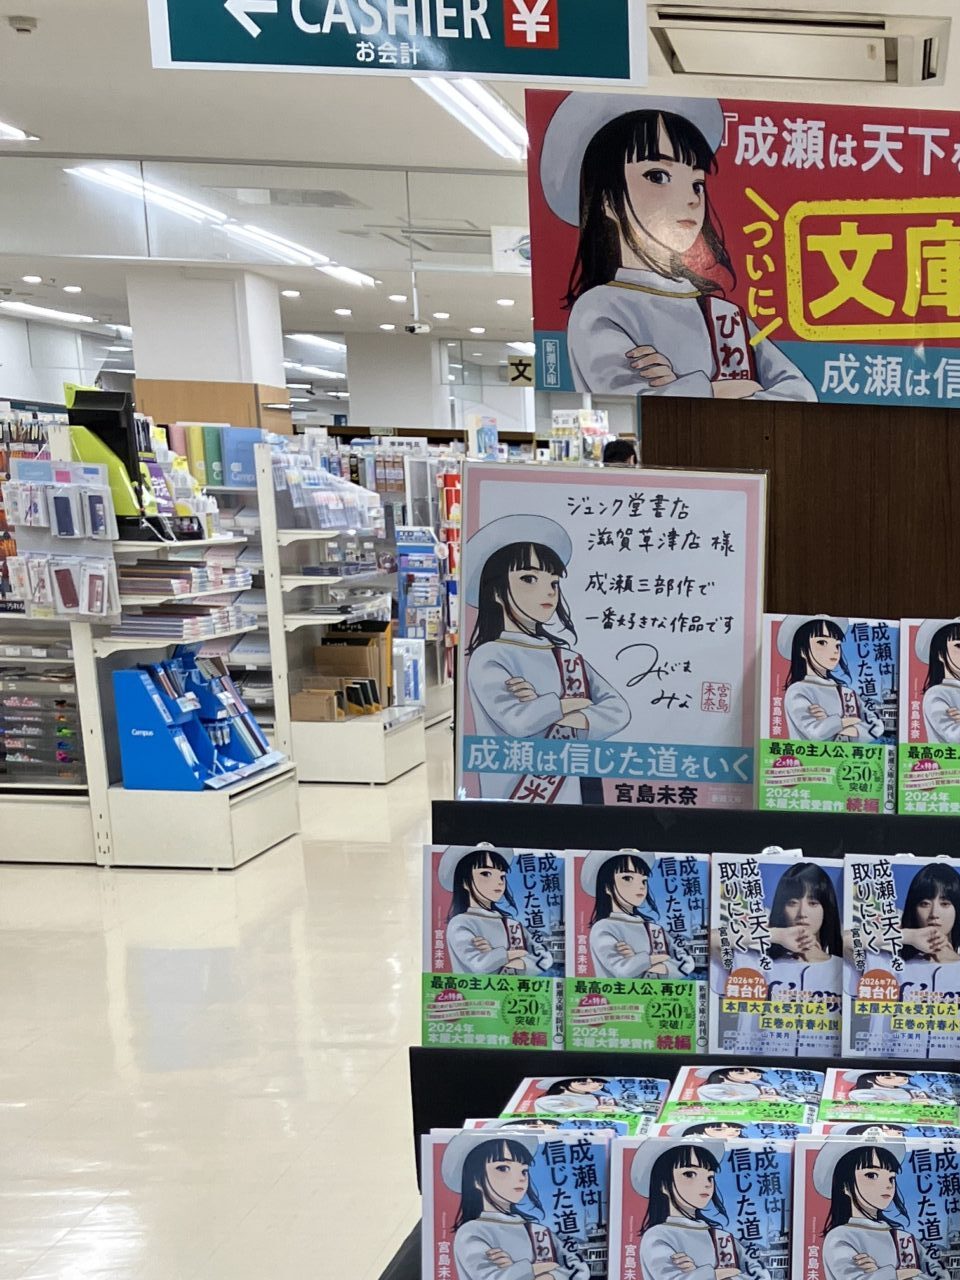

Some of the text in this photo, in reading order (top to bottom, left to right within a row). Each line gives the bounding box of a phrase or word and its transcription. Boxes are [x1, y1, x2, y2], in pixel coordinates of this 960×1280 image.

[355, 41, 420, 65] お会計
[744, 221, 777, 318] ついに
[510, 359, 532, 384] 文
[545, 340, 557, 386] 新潮文庫
[567, 493, 689, 519] ジュンク堂書店
[587, 527, 735, 557] 滋賀草津店 様
[584, 572, 715, 596] 成瀬三部作で
[585, 607, 735, 635] 一番好きな作品です
[872, 622, 893, 675] 成瀬は
[851, 623, 880, 740] 信じた道をいく
[131, 728, 154, 737] Campus
[467, 741, 749, 782] 成瀬は信じた道をいく
[769, 743, 883, 760] 最高の主人公、再び!
[614, 783, 698, 806] 宮島未奈
[539, 853, 562, 906] 成瀬は
[680, 856, 702, 911] 成瀬は
[517, 853, 549, 973] 信じた道をいく
[658, 857, 689, 977] 信じた道をいく
[719, 862, 748, 953] 取りにいく
[741, 859, 772, 972] 成瀬は天下を
[851, 863, 880, 954] 取りにいく
[874, 859, 904, 972] 成瀬は天下を
[431, 976, 550, 993] 最高の主人公、再び!
[575, 980, 694, 997] 最高の主人公、再び!
[726, 984, 767, 999] 舞台化
[859, 985, 899, 1000] 舞台化
[725, 1002, 825, 1016] 本屋大賞を受賞した
[857, 1003, 957, 1016] 本屋大賞を受賞した
[761, 1018, 839, 1031] 圧巻の青春小説
[570, 1136, 599, 1206] 成瀬は
[754, 1147, 782, 1214] 成瀬は
